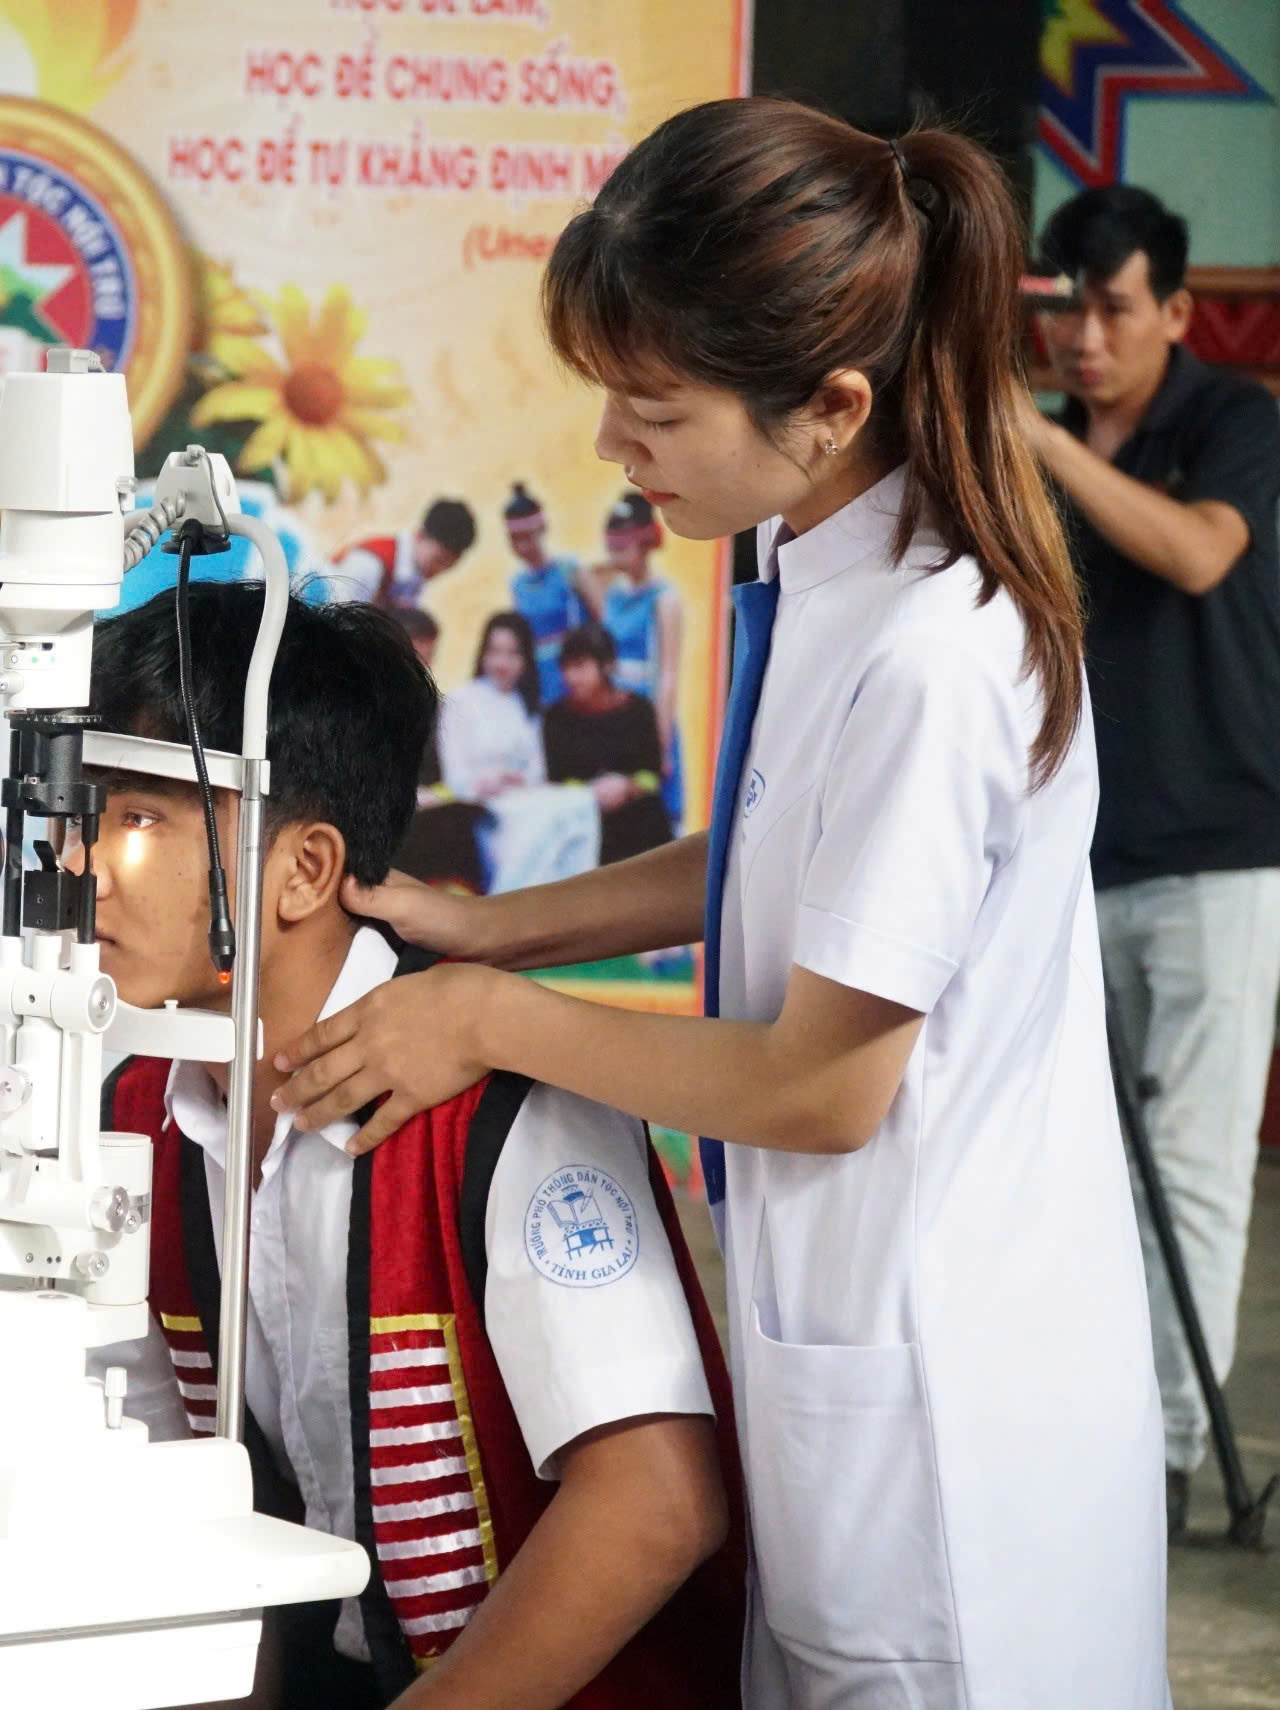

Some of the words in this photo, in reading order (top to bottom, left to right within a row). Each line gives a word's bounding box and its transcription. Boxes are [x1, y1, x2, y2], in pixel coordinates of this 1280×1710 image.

[245, 50, 324, 109] HỌC
[386, 57, 507, 103] CHUNG
[169, 136, 245, 195] HỌC
[592, 1265, 616, 1279] GIA
[616, 1247, 632, 1268] LAI
